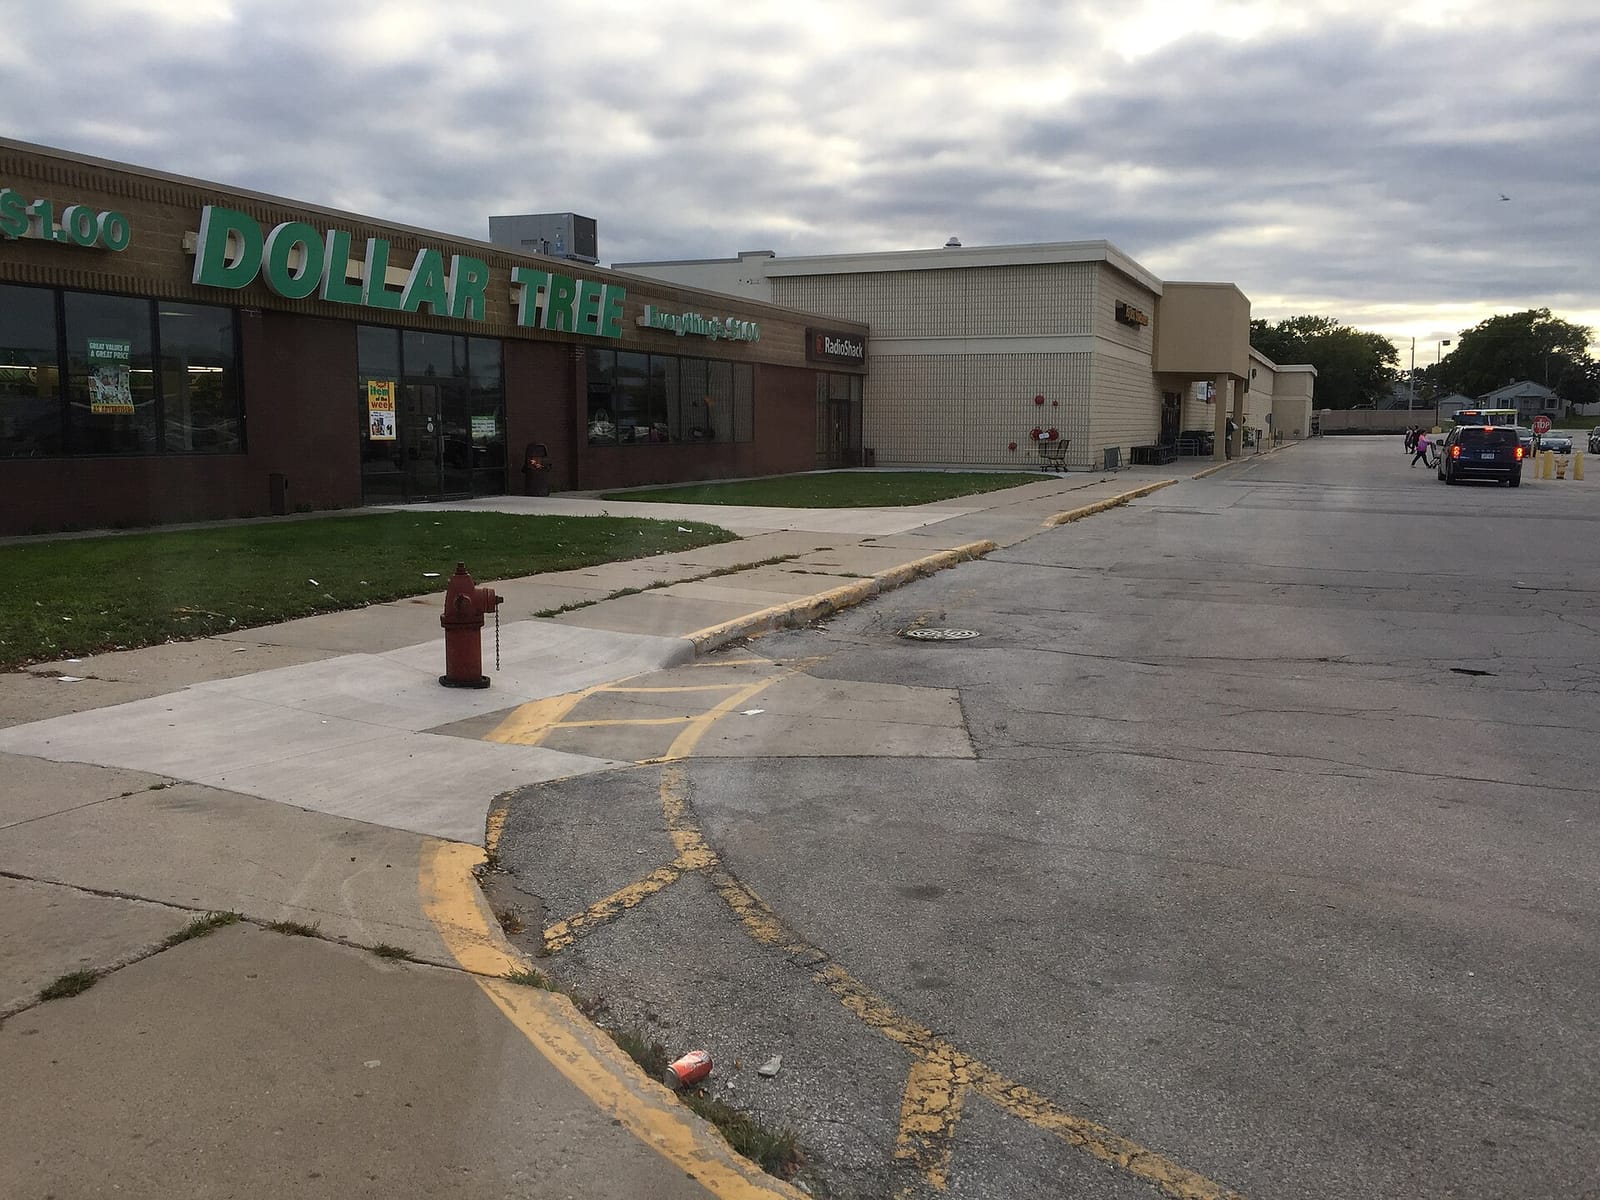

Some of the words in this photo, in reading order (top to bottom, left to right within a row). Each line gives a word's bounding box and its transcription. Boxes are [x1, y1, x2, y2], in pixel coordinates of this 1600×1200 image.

[0, 188, 131, 252] $1.00
[192, 205, 489, 321] DOLLAR
[511, 266, 626, 339] TREE
[89, 342, 104, 350] GREAT
[113, 352, 129, 360] PRICE
[825, 336, 863, 358] RadioShack
